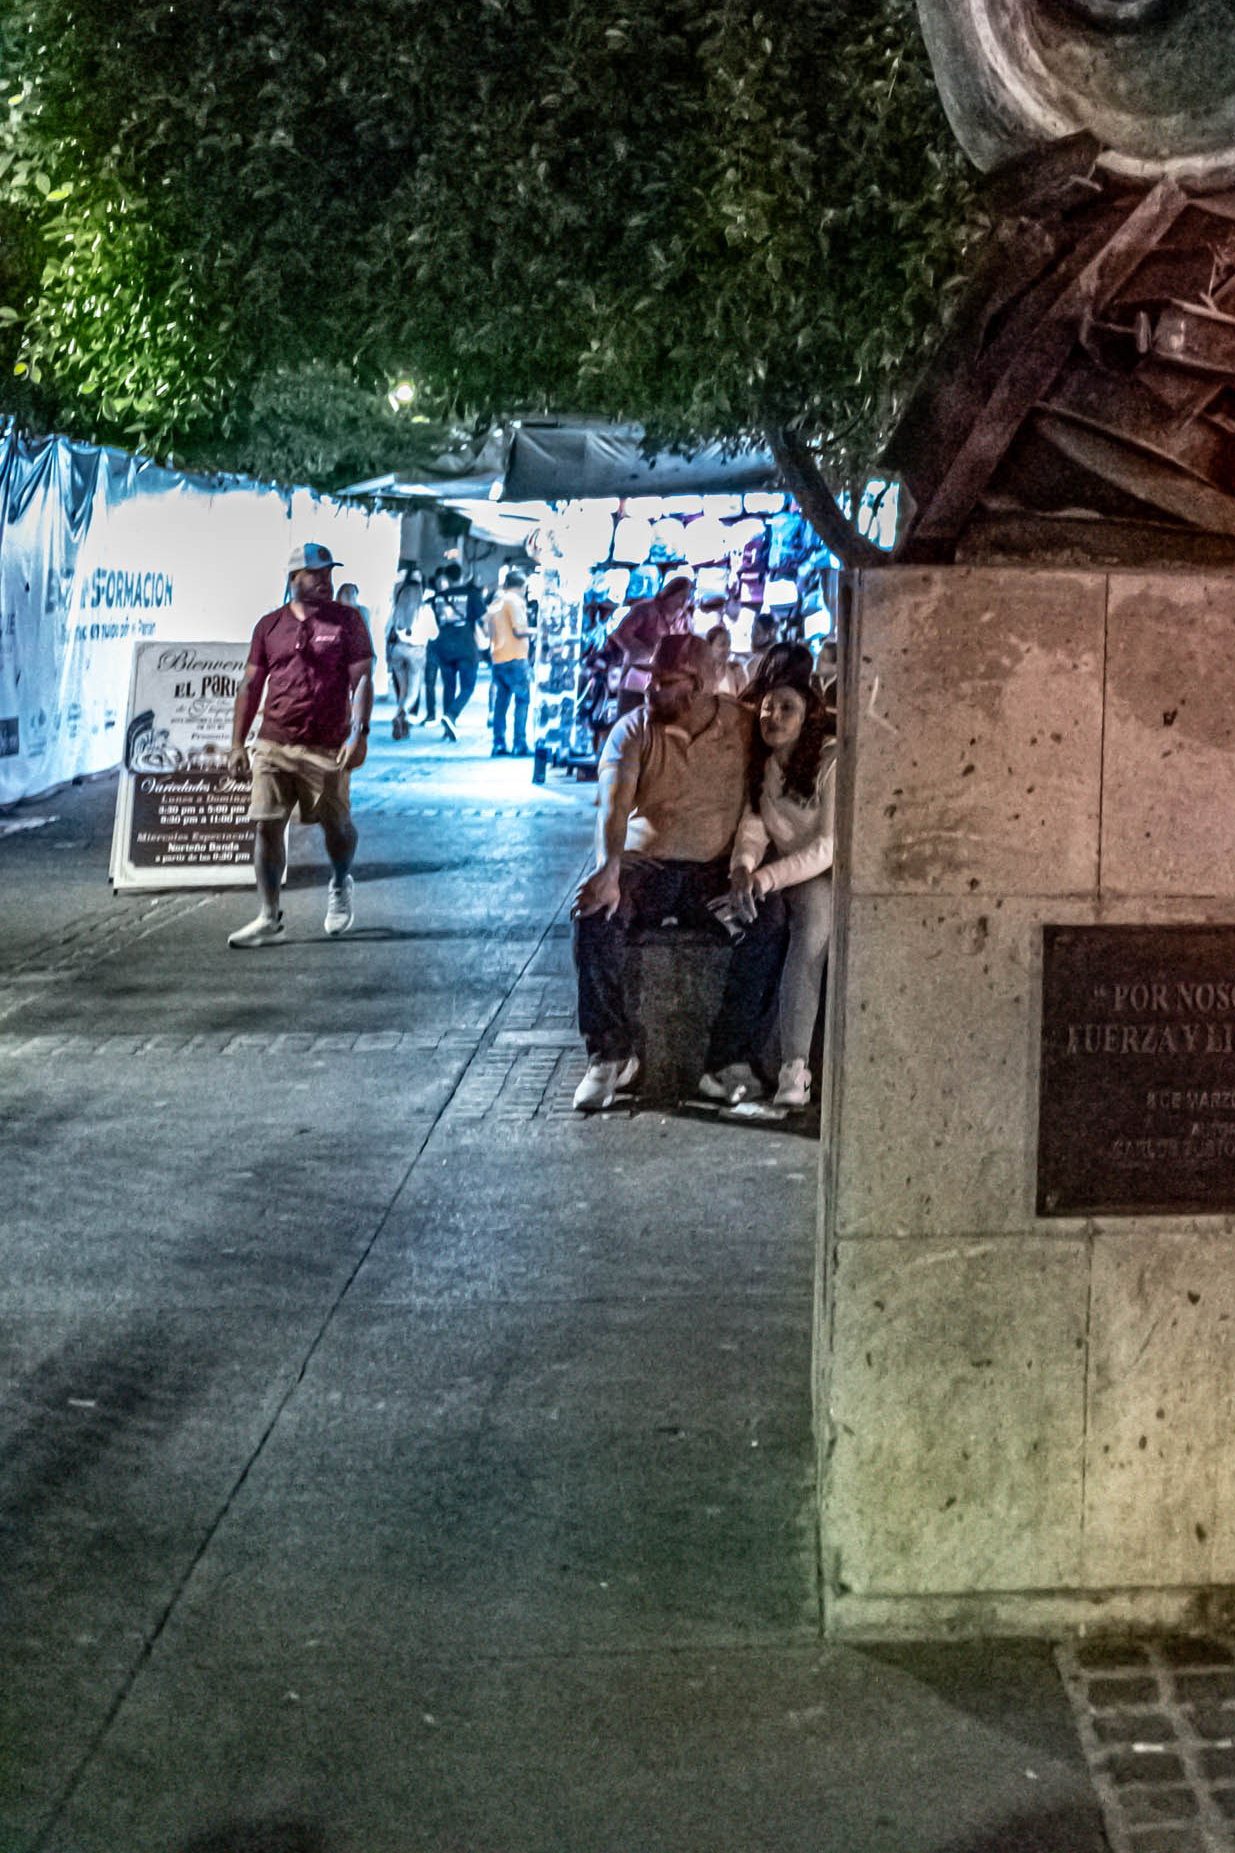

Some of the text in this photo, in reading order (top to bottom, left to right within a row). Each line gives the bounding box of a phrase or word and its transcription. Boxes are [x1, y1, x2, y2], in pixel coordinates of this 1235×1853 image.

[174, 681, 196, 698] EL
[208, 841, 240, 852] Banda
[1178, 1023, 1201, 1053] Y
